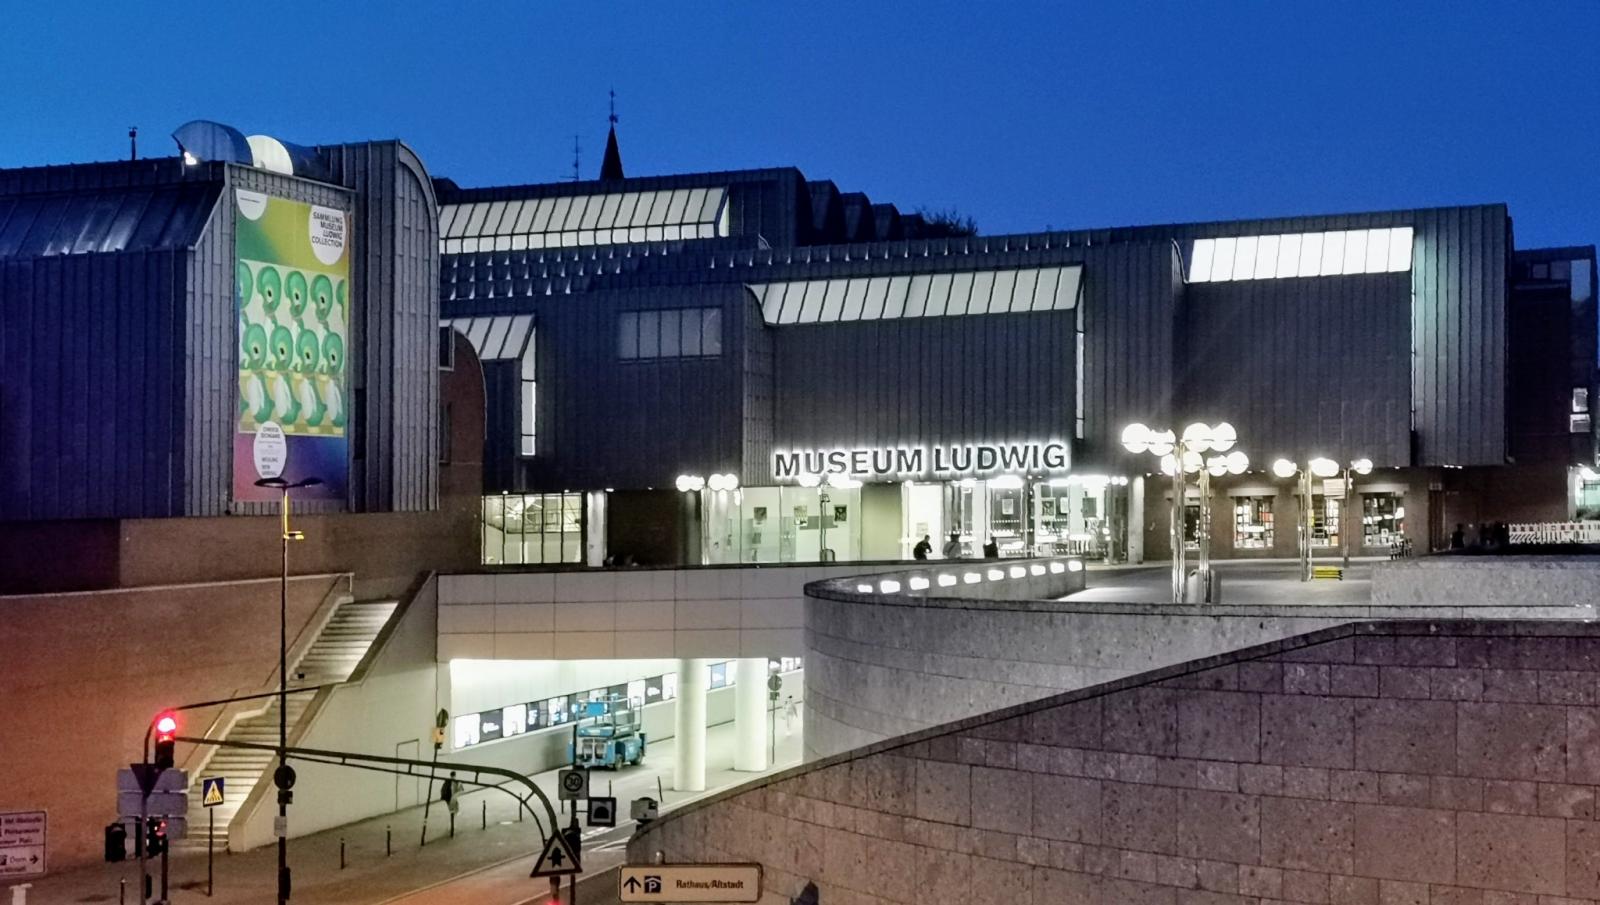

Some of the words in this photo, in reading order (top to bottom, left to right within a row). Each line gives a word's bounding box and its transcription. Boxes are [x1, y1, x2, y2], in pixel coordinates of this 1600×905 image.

[320, 221, 343, 231] MUSEUM
[323, 230, 342, 240] LUDWIG
[311, 235, 343, 248] COLLECTION
[775, 448, 922, 477] MUSEUM
[935, 443, 1066, 472] LUDWIG
